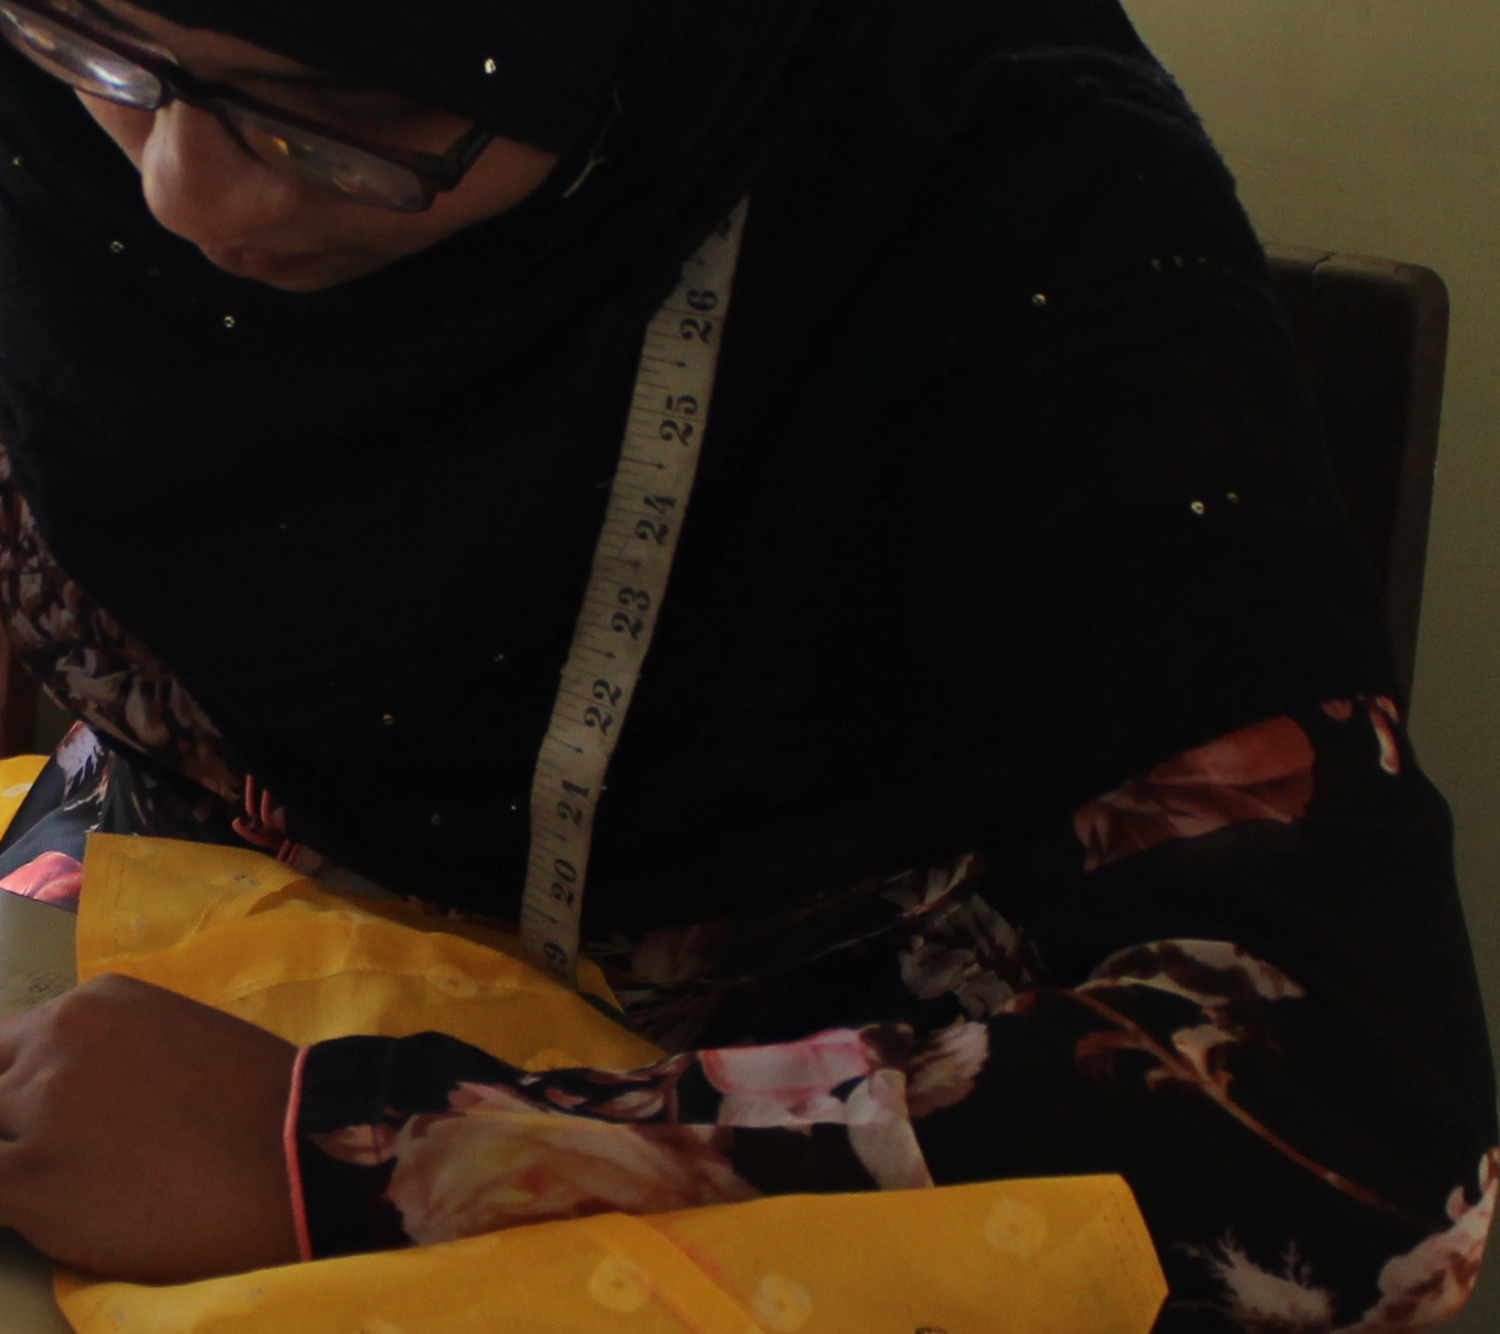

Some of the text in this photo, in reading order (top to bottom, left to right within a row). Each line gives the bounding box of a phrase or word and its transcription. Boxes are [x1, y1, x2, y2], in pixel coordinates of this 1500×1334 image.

[679, 289, 720, 344] 26
[658, 394, 699, 445] 25
[636, 492, 678, 547] 24
[611, 586, 653, 639] 23
[583, 678, 624, 734] 22
[555, 780, 592, 826] 21
[551, 857, 579, 910] 20
